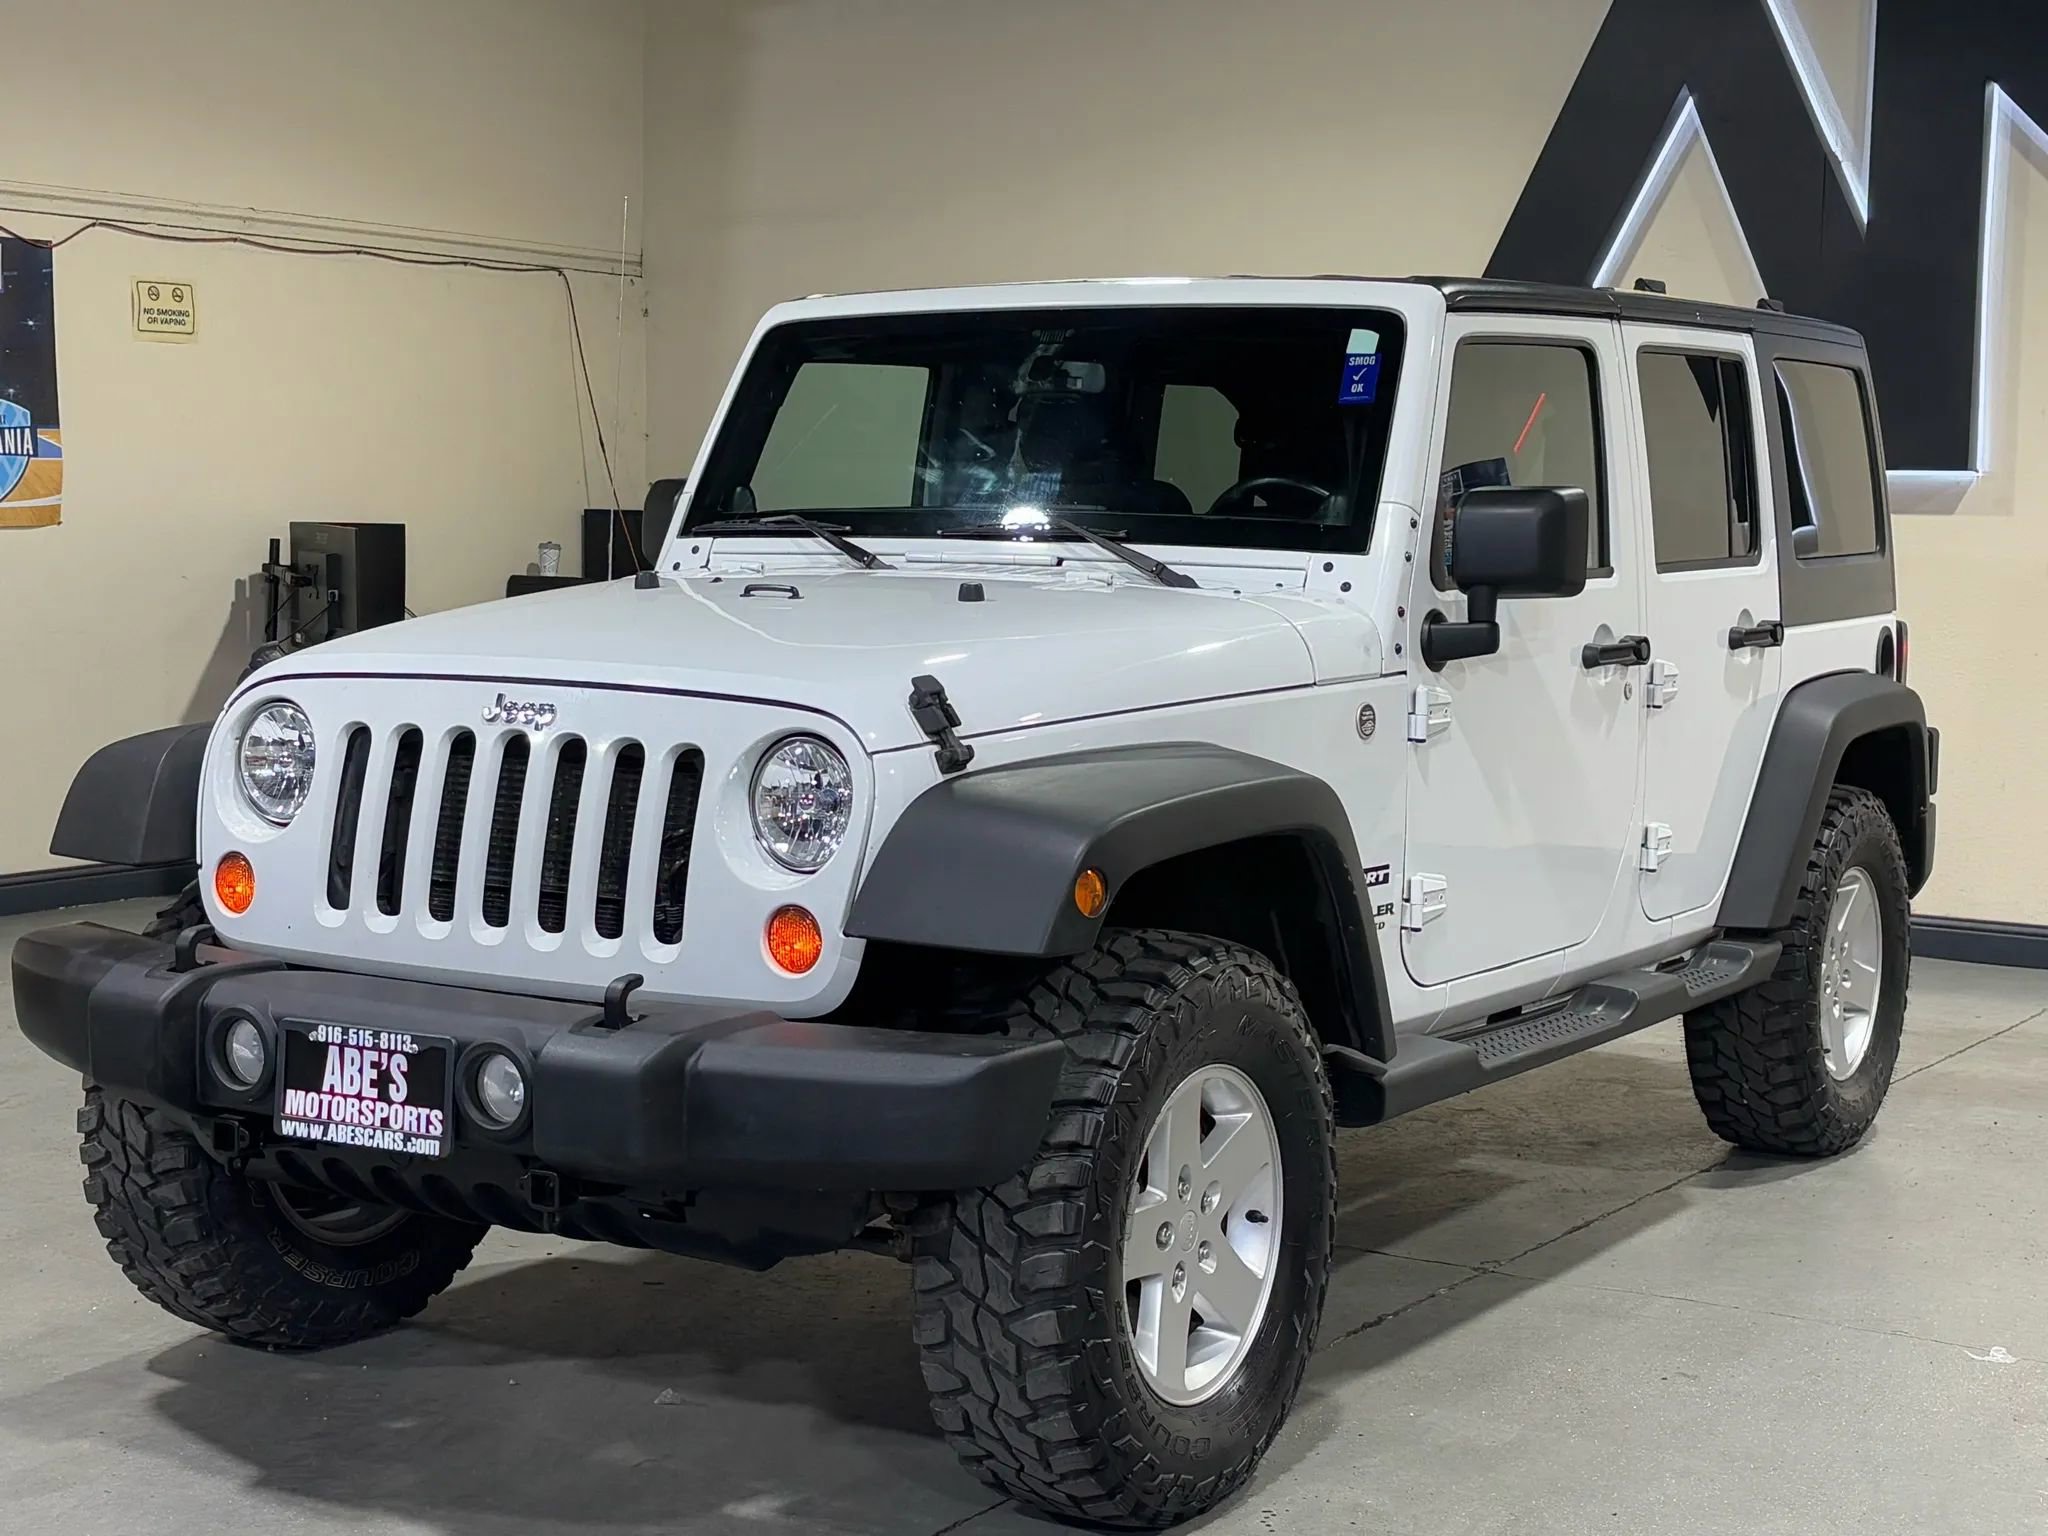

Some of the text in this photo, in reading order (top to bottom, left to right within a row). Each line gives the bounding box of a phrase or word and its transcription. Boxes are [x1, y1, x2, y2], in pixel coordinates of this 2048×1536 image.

[156, 308, 190, 317] SMOKING
[160, 317, 186, 326] VAPING
[1348, 356, 1376, 366] SMOG
[1351, 383, 1364, 393] OK
[482, 692, 557, 731] Jeep
[317, 1024, 413, 1053] 916-515-8113
[321, 1044, 409, 1103] ABE'S
[284, 1088, 444, 1136] MOTORSPORTS
[265, 1225, 421, 1290] COURSER
[1113, 1299, 1212, 1460] COURSER
